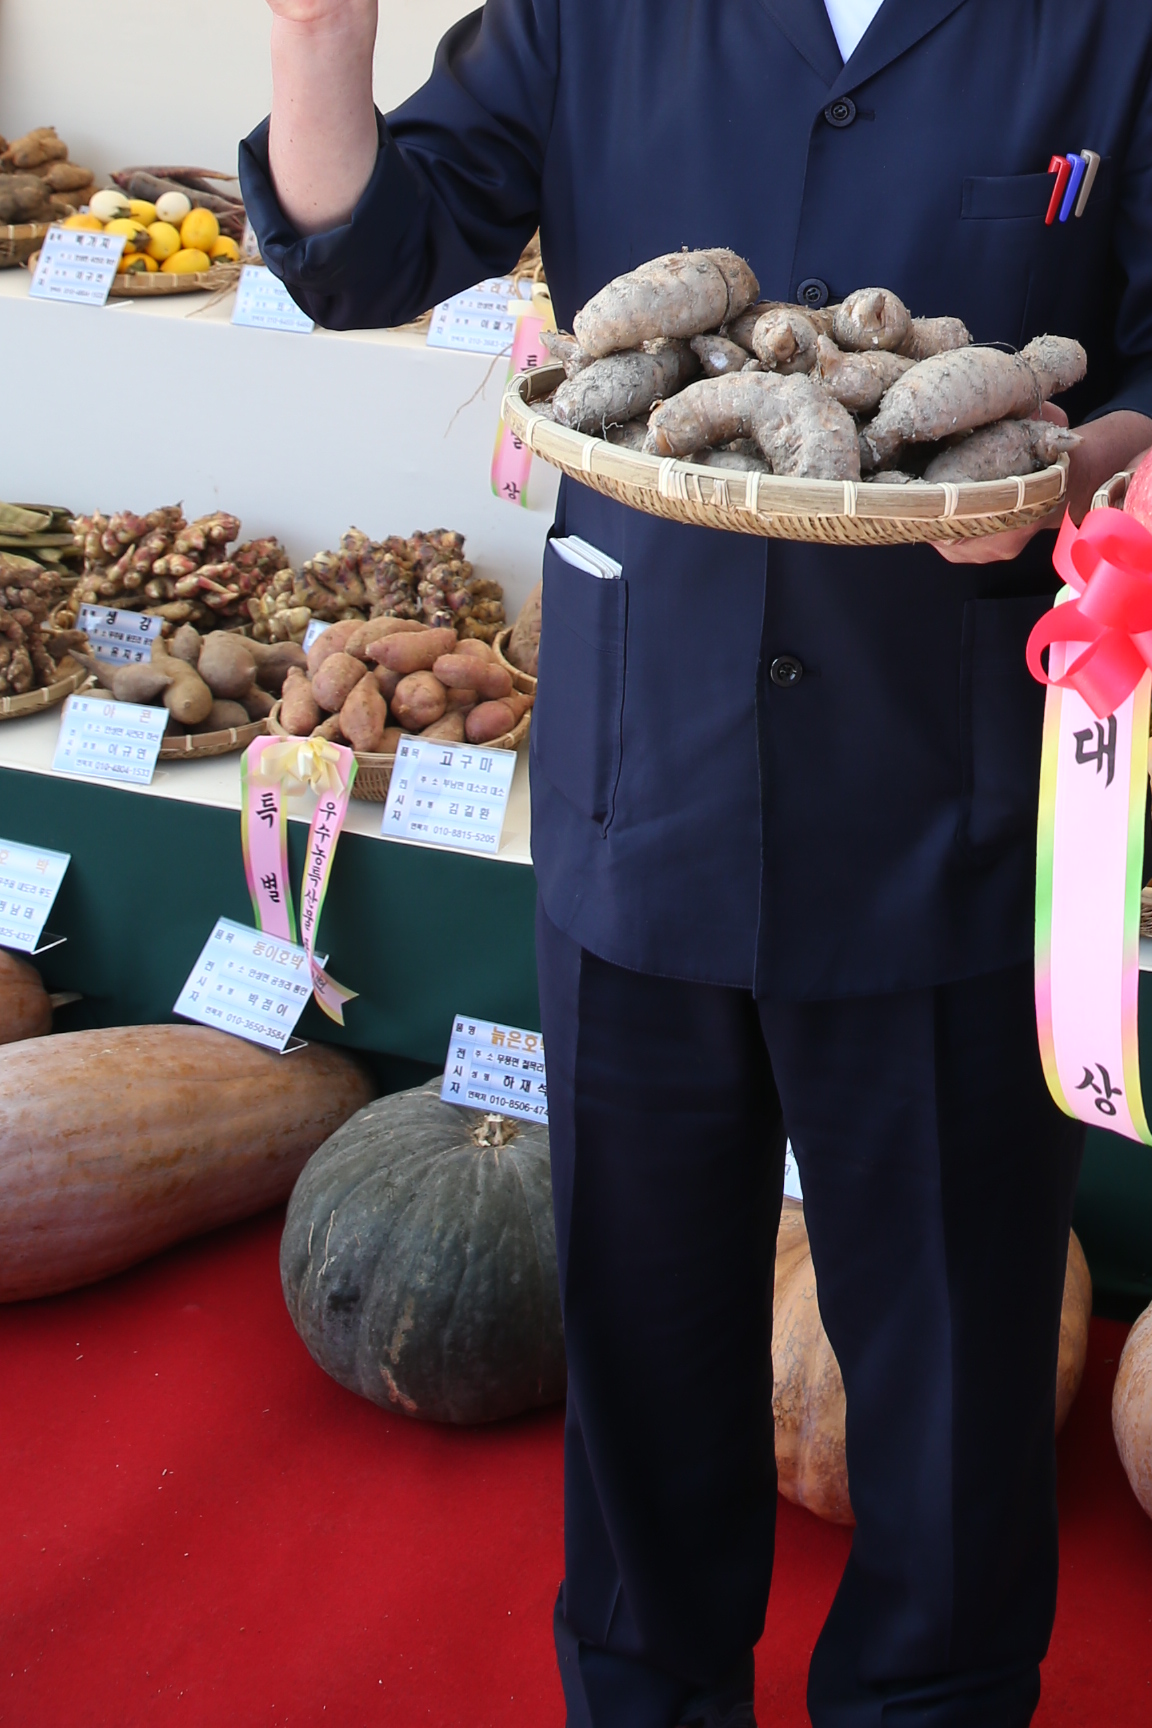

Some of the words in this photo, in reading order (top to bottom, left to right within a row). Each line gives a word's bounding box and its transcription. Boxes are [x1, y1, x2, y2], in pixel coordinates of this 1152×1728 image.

[440, 750, 493, 773] 고구마
[448, 802, 490, 821] 김길환
[433, 825, 496, 844] 010-8815-5205
[226, 1013, 287, 1041] 010-3650-3584
[491, 1025, 545, 1054] 늙은호
[449, 1047, 467, 1094] 전시자
